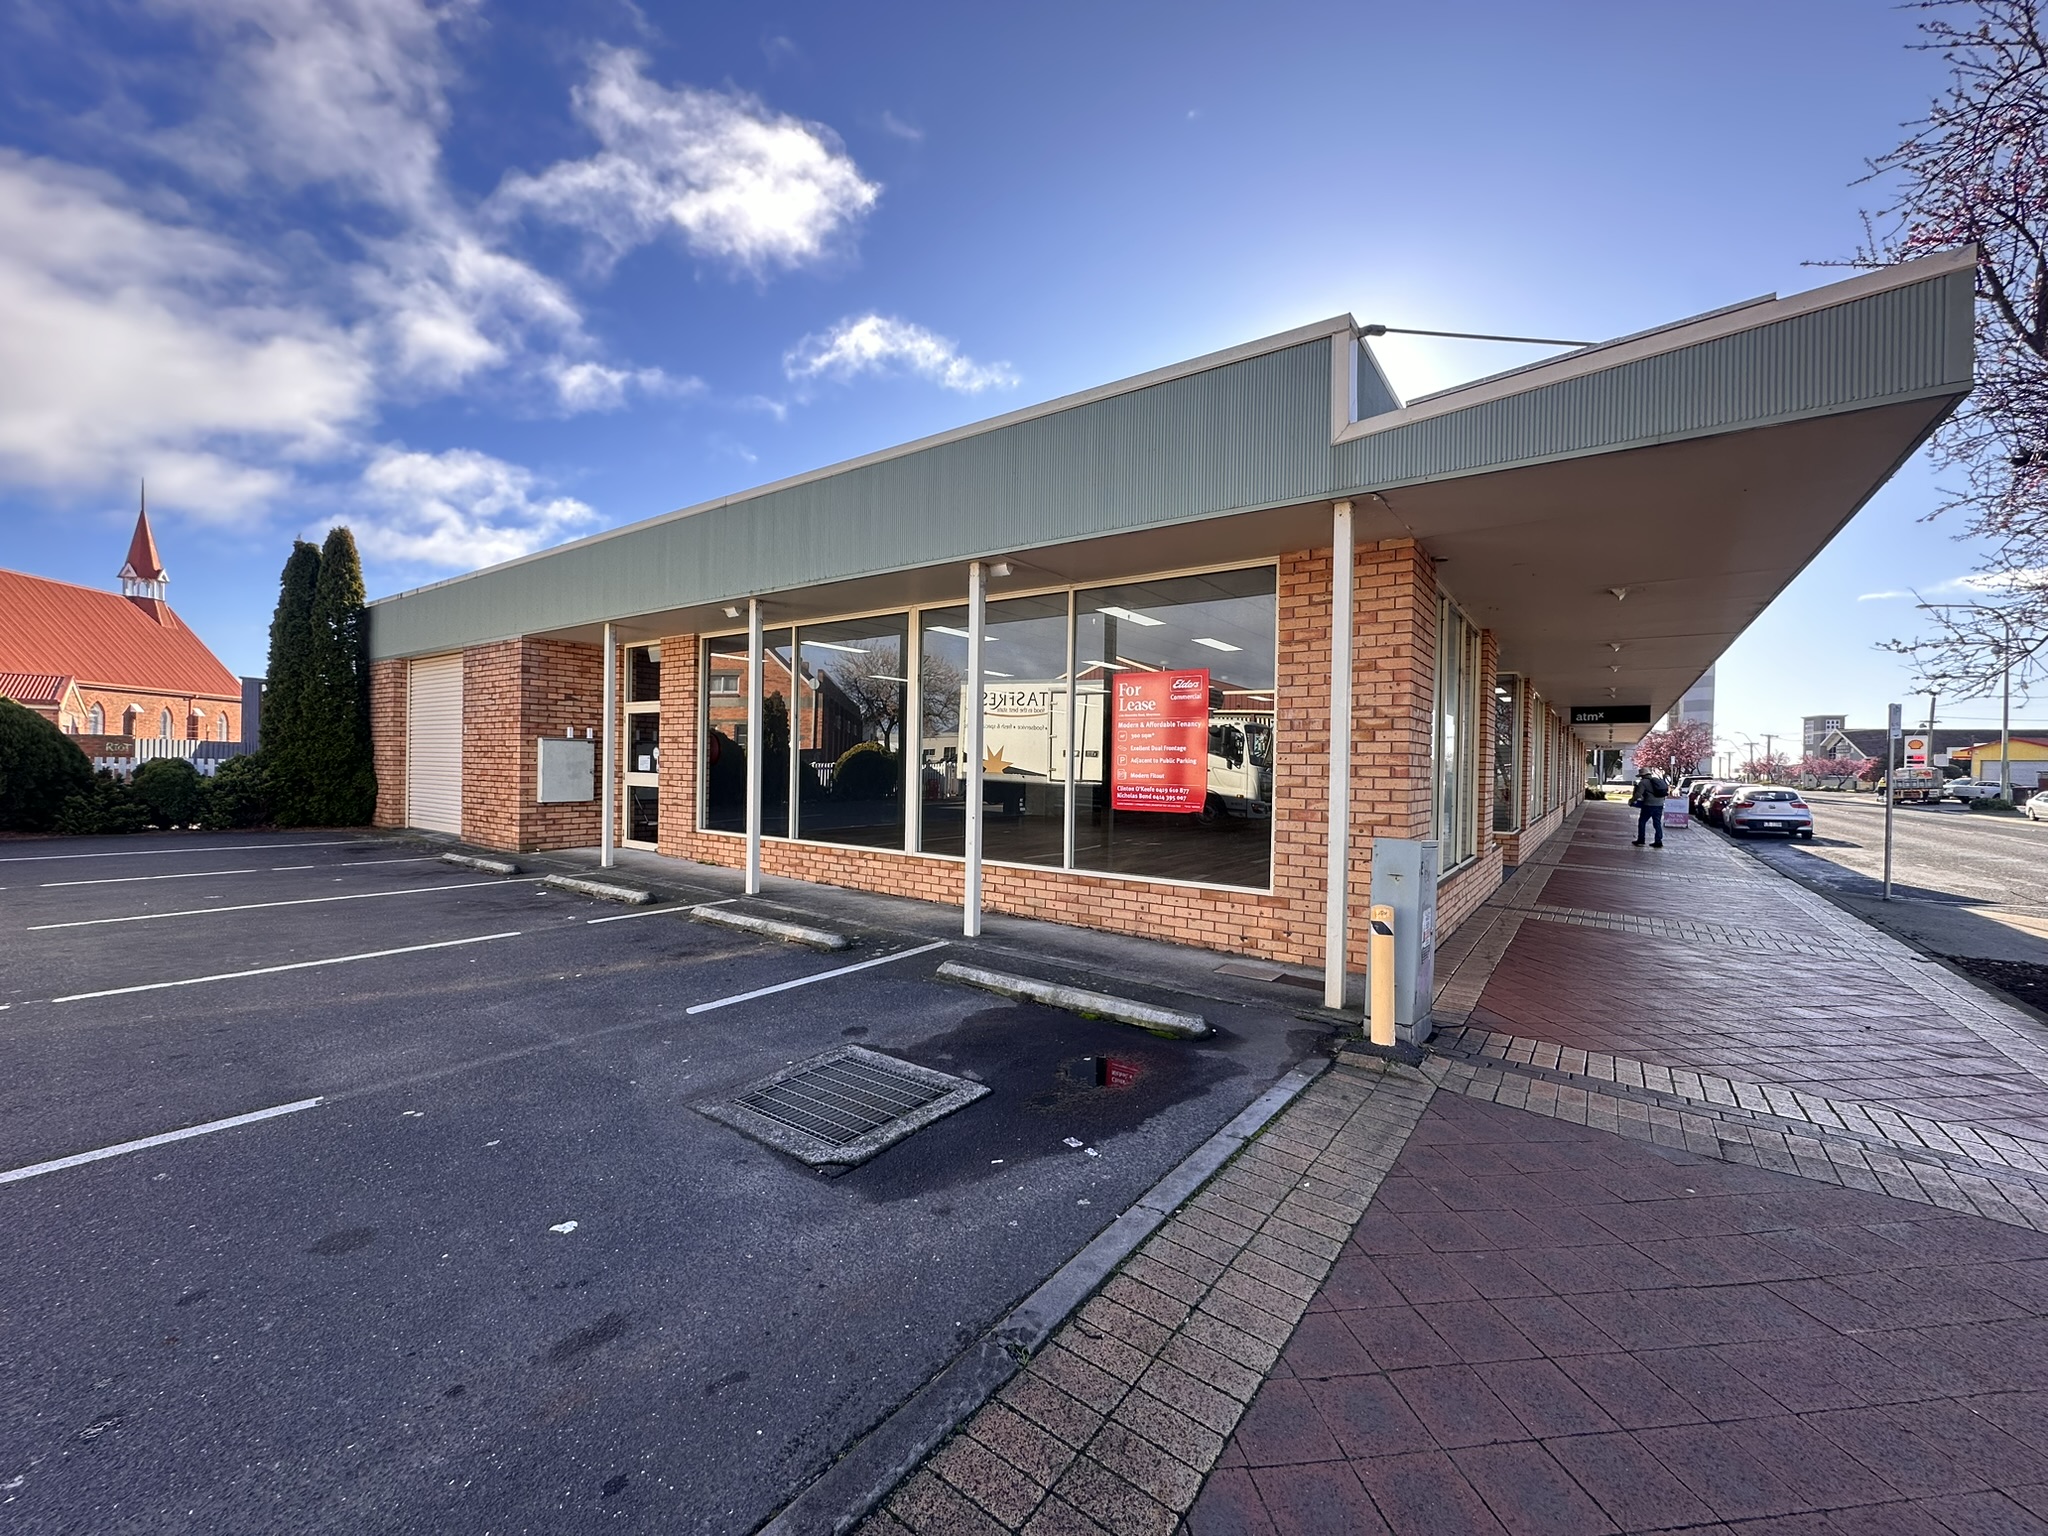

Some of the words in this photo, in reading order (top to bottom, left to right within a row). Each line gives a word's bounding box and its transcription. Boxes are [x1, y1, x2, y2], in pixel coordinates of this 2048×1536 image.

[1172, 679, 1200, 689] Elders
[1119, 683, 1141, 697] For
[1170, 693, 1201, 701] Commercial
[1119, 698, 1156, 712] Lease
[1177, 720, 1201, 729] Tenancy
[1163, 745, 1187, 753] Frontage
[1130, 757, 1154, 765] Adjacent
[1176, 757, 1197, 765] Parking
